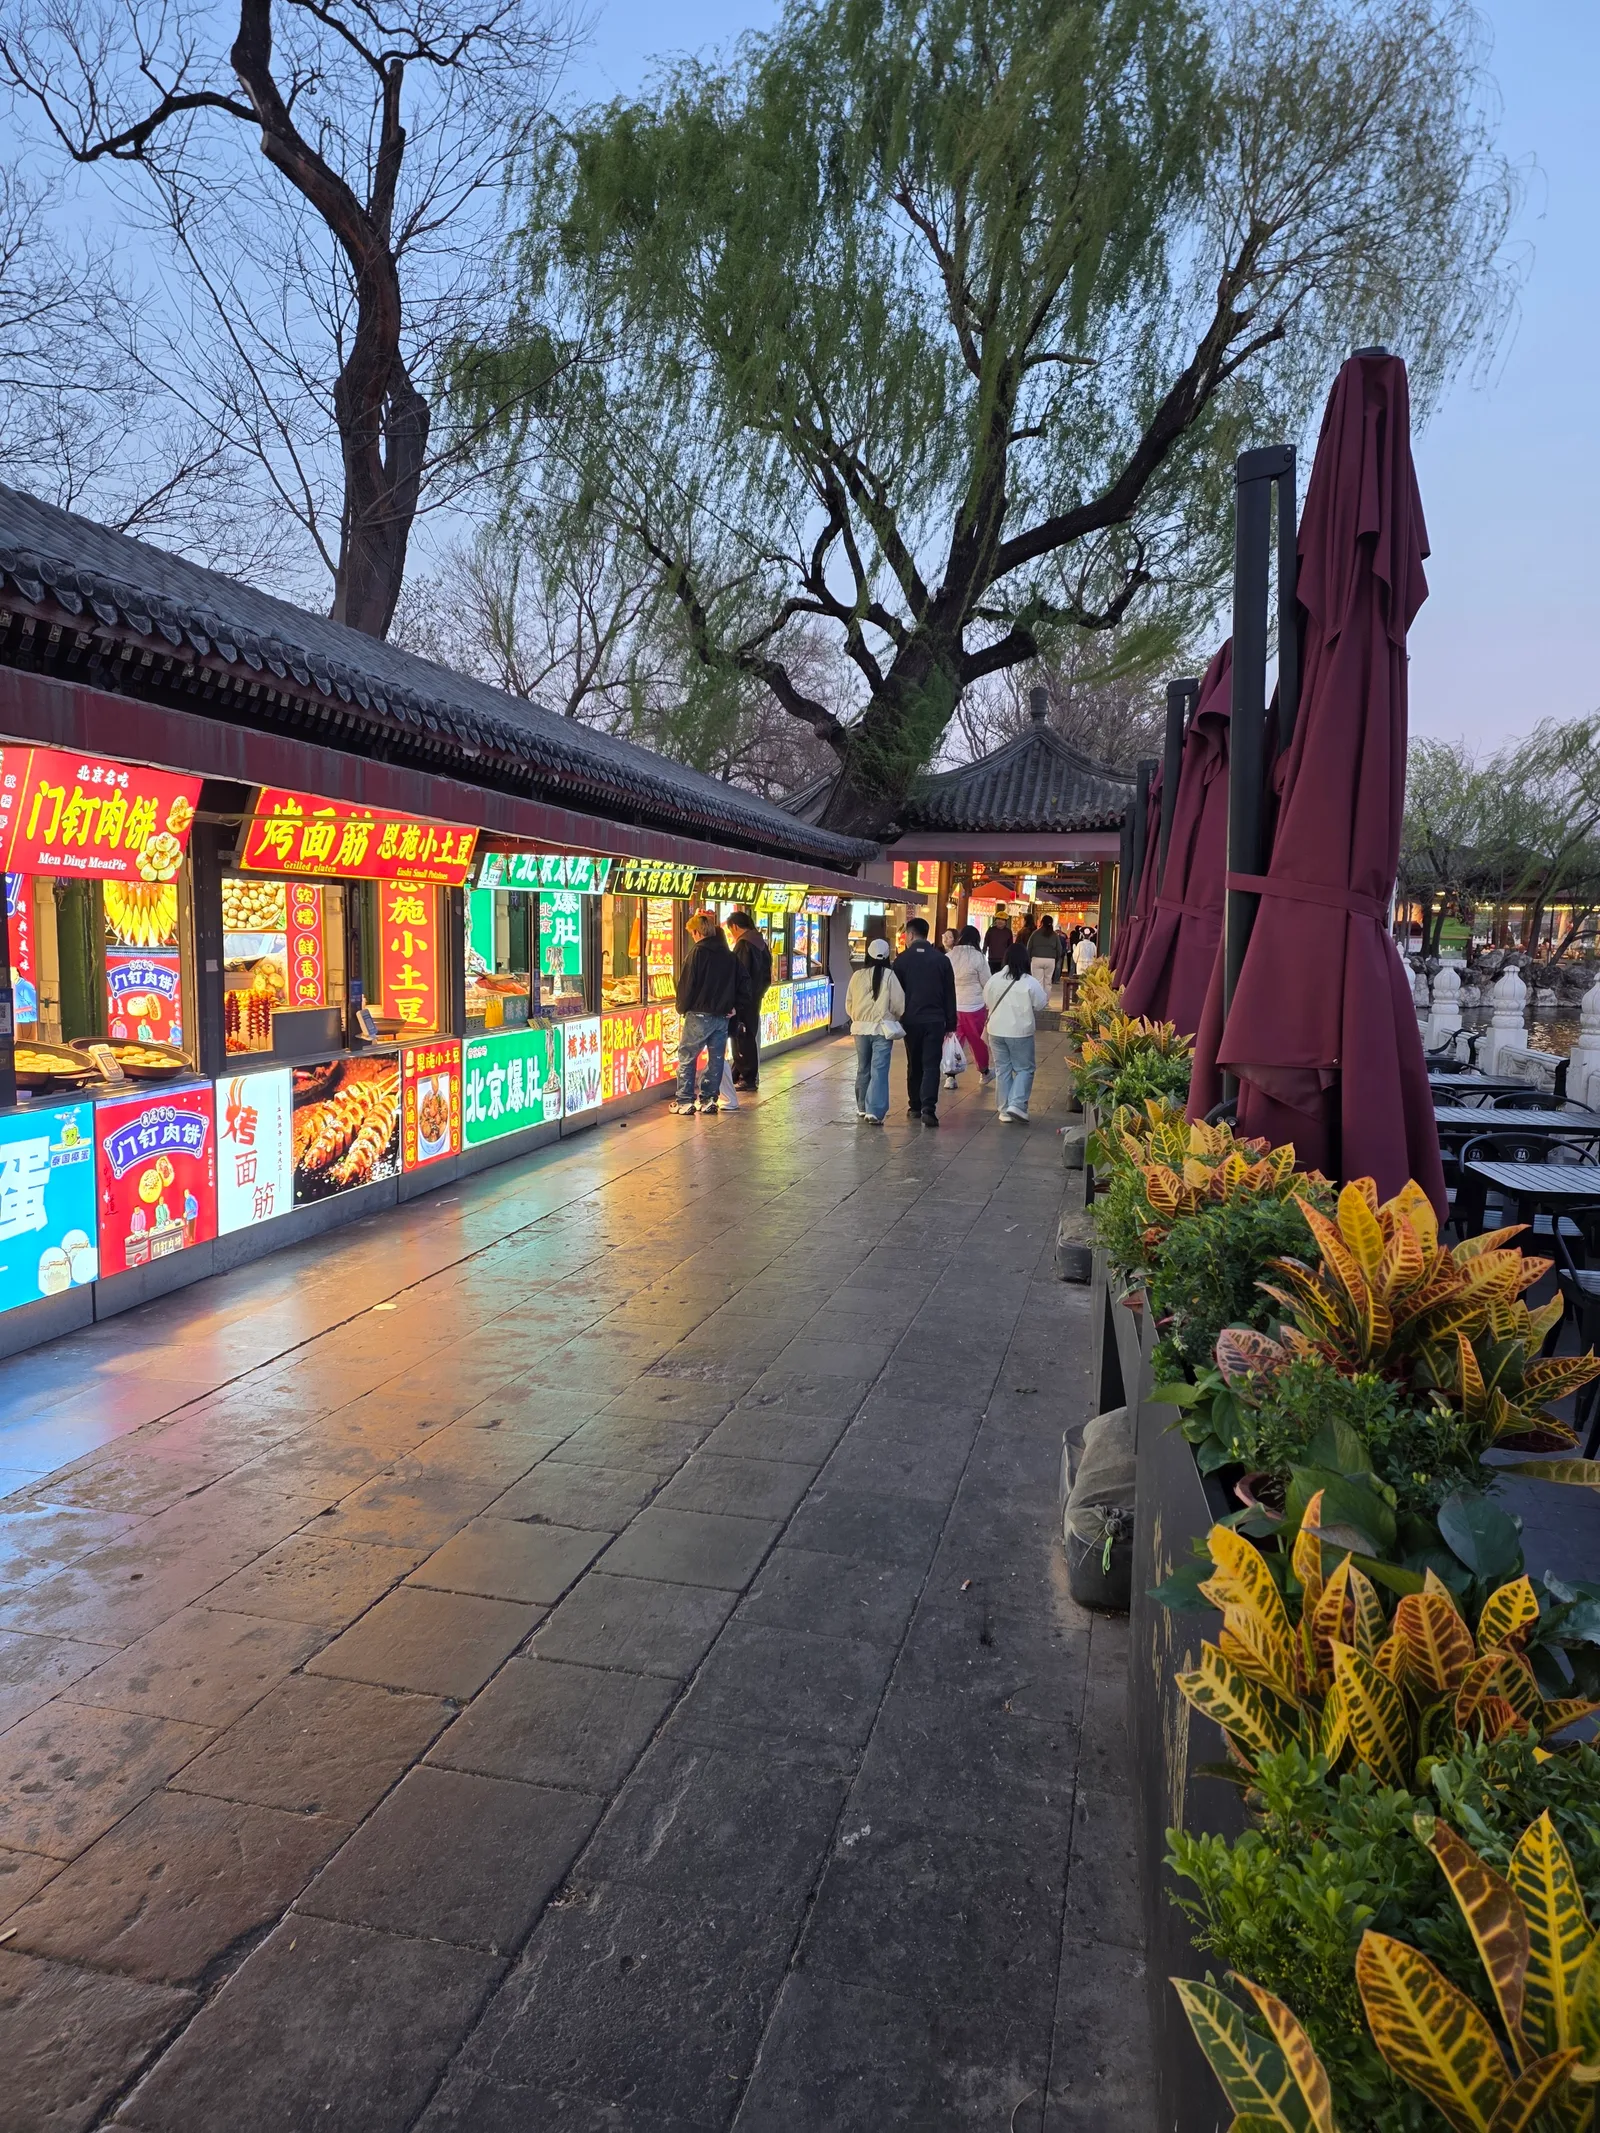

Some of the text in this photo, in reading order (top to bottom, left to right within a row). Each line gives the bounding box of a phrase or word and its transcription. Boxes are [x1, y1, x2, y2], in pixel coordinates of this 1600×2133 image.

[76, 764, 129, 788] 北京名吃
[26, 780, 159, 852] 门钉肉饼
[254, 798, 375, 866] 烤面筋
[37, 851, 128, 871] Men Ding MeatPie
[376, 823, 474, 867] 恩施小土豆
[283, 859, 337, 874] Grilled gluten
[539, 902, 552, 934] 北京
[114, 970, 173, 991] 门钉肉饼
[297, 938, 318, 1006] 鲜香味
[417, 1047, 460, 1072] 恩施小土豆
[466, 1055, 541, 1123] 北京爆肚
[117, 1123, 200, 1165] 门钉肉饼
[220, 1079, 275, 1220] 烤面筋
